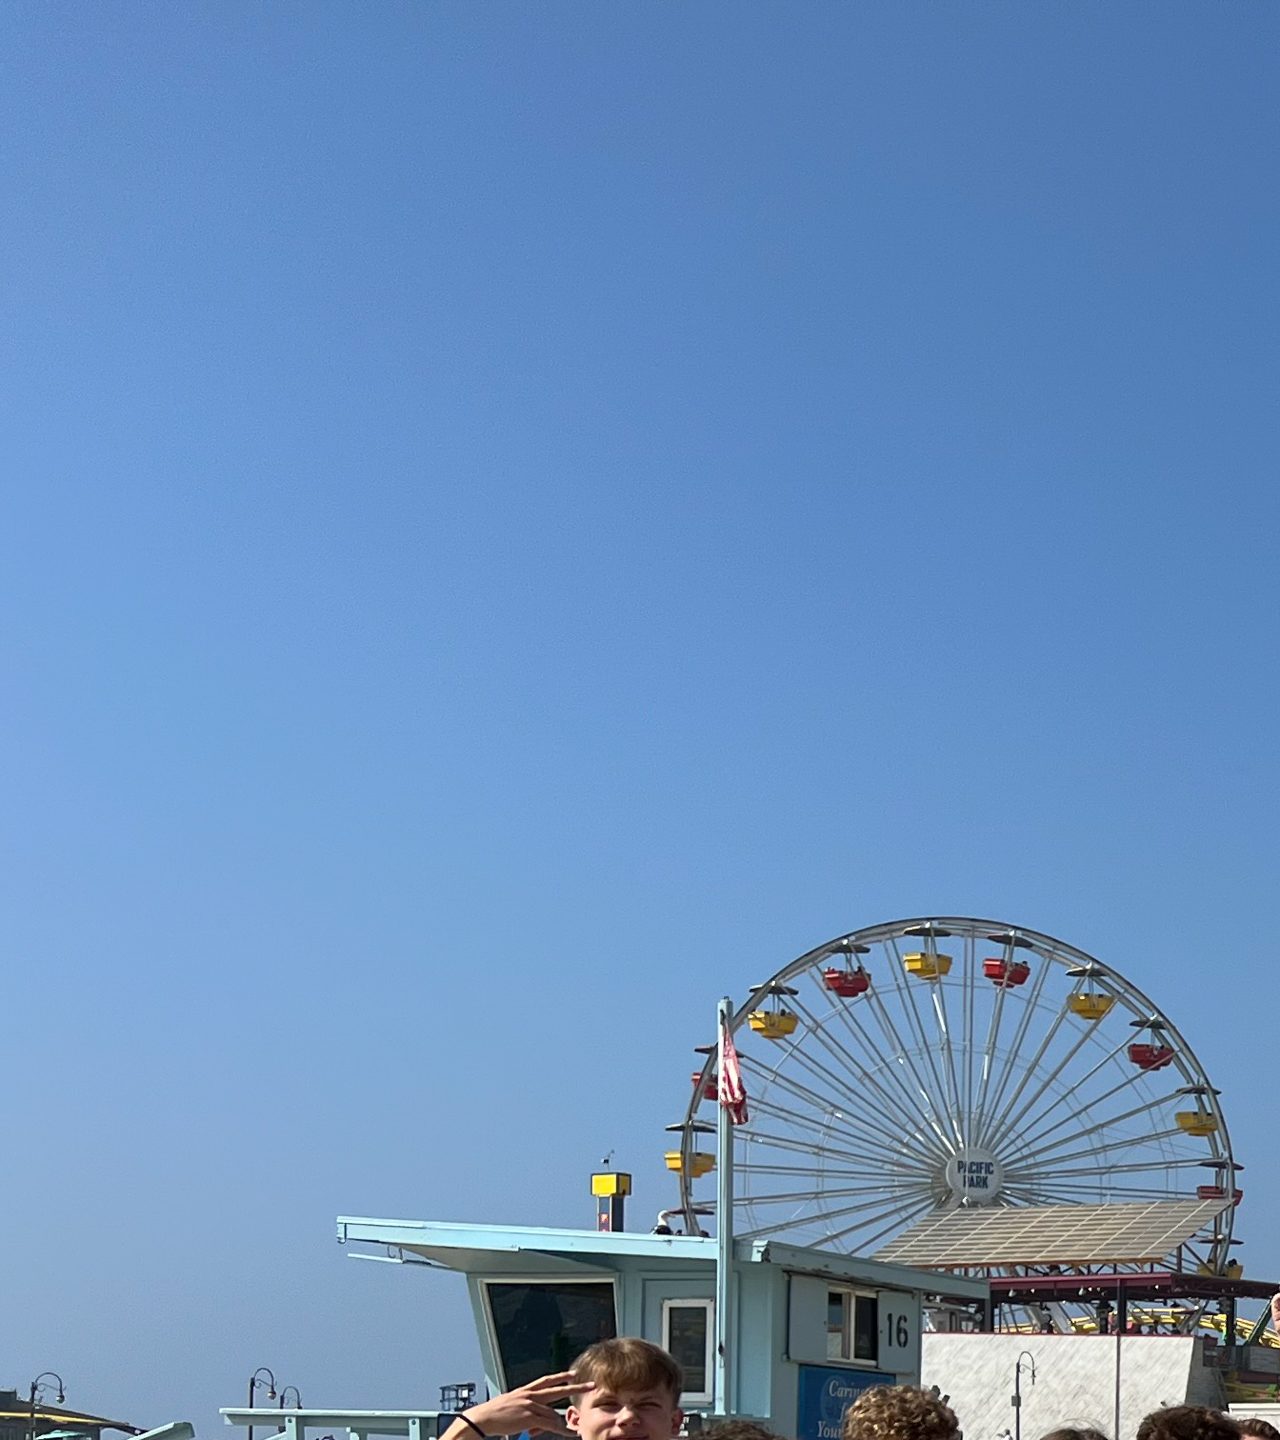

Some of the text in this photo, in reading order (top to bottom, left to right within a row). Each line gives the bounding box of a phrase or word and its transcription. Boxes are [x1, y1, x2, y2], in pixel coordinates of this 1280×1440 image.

[957, 1161, 994, 1175] PACIFIC
[963, 1175, 989, 1189] PARK
[887, 1313, 908, 1348] 16
[829, 1380, 864, 1397] Carin
